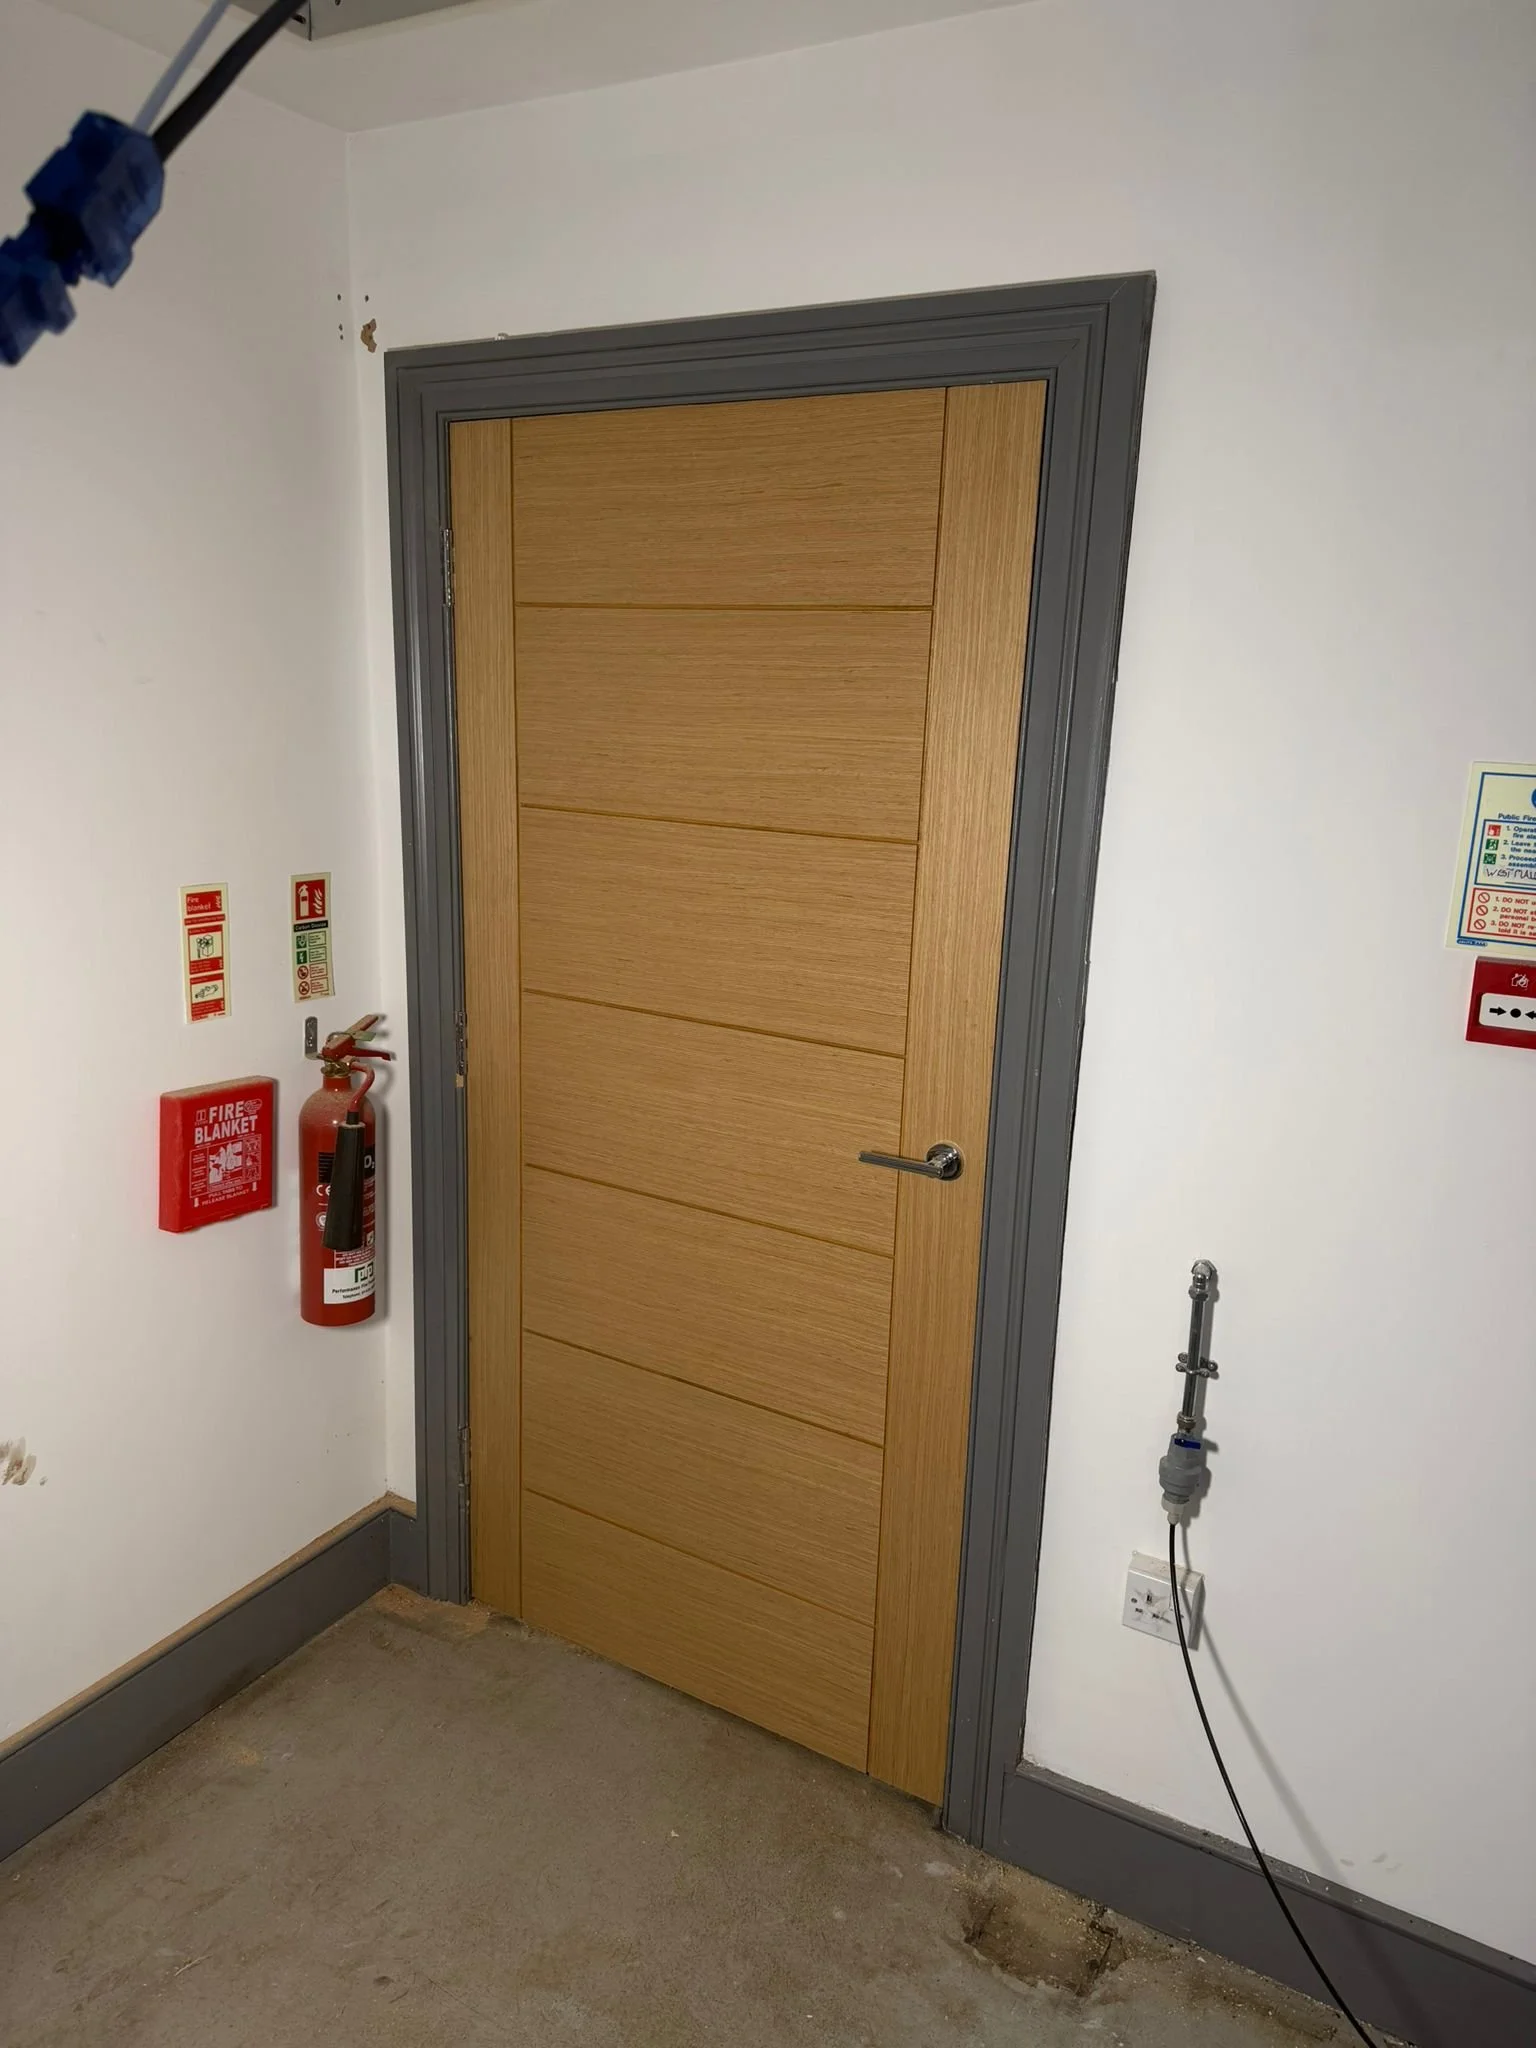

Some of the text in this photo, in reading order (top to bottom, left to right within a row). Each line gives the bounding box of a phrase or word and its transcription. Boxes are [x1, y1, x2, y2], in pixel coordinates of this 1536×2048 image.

[1498, 813, 1520, 821] Public
[1511, 840, 1531, 848] Leave
[187, 901, 211, 912] blanket
[209, 1100, 244, 1124] FIRE
[194, 1115, 259, 1145] BLANKET
